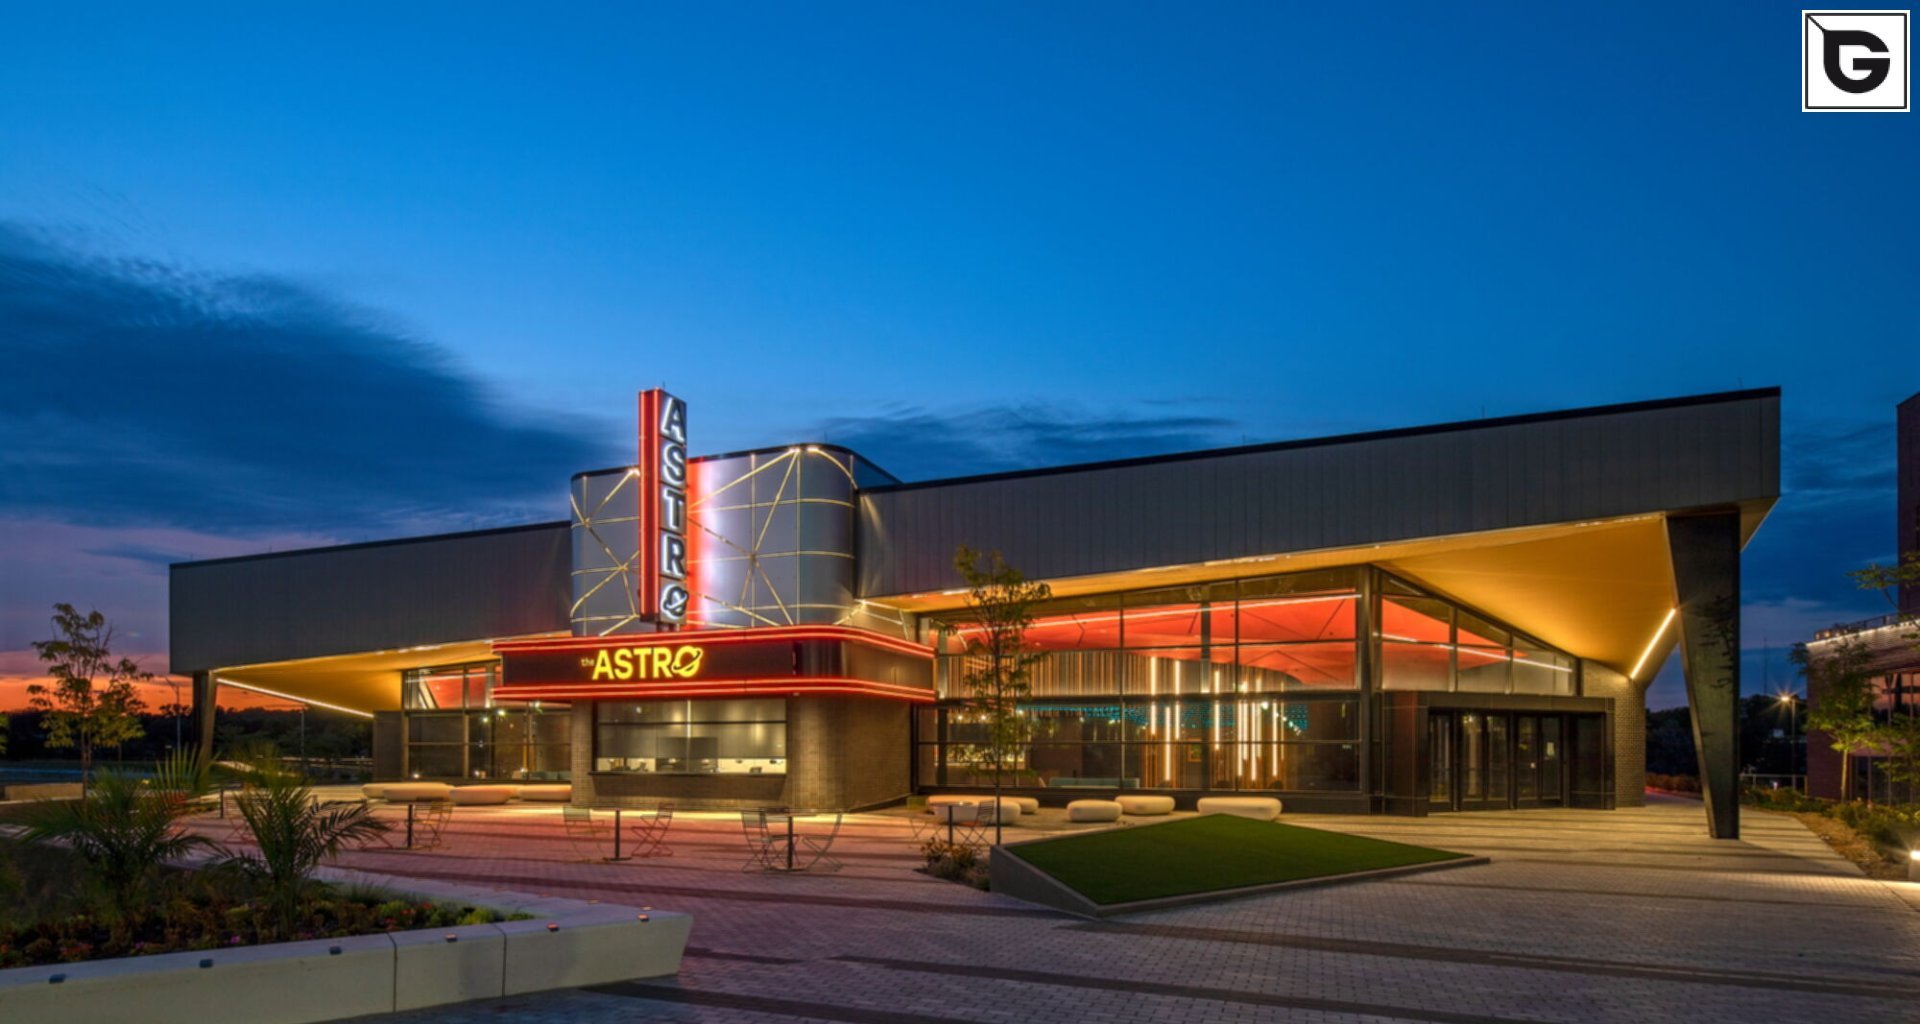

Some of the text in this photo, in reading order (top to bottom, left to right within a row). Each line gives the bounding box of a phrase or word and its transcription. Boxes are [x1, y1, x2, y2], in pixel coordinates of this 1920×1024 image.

[660, 397, 689, 619] ASTRO
[581, 645, 703, 680] the ASTRO
